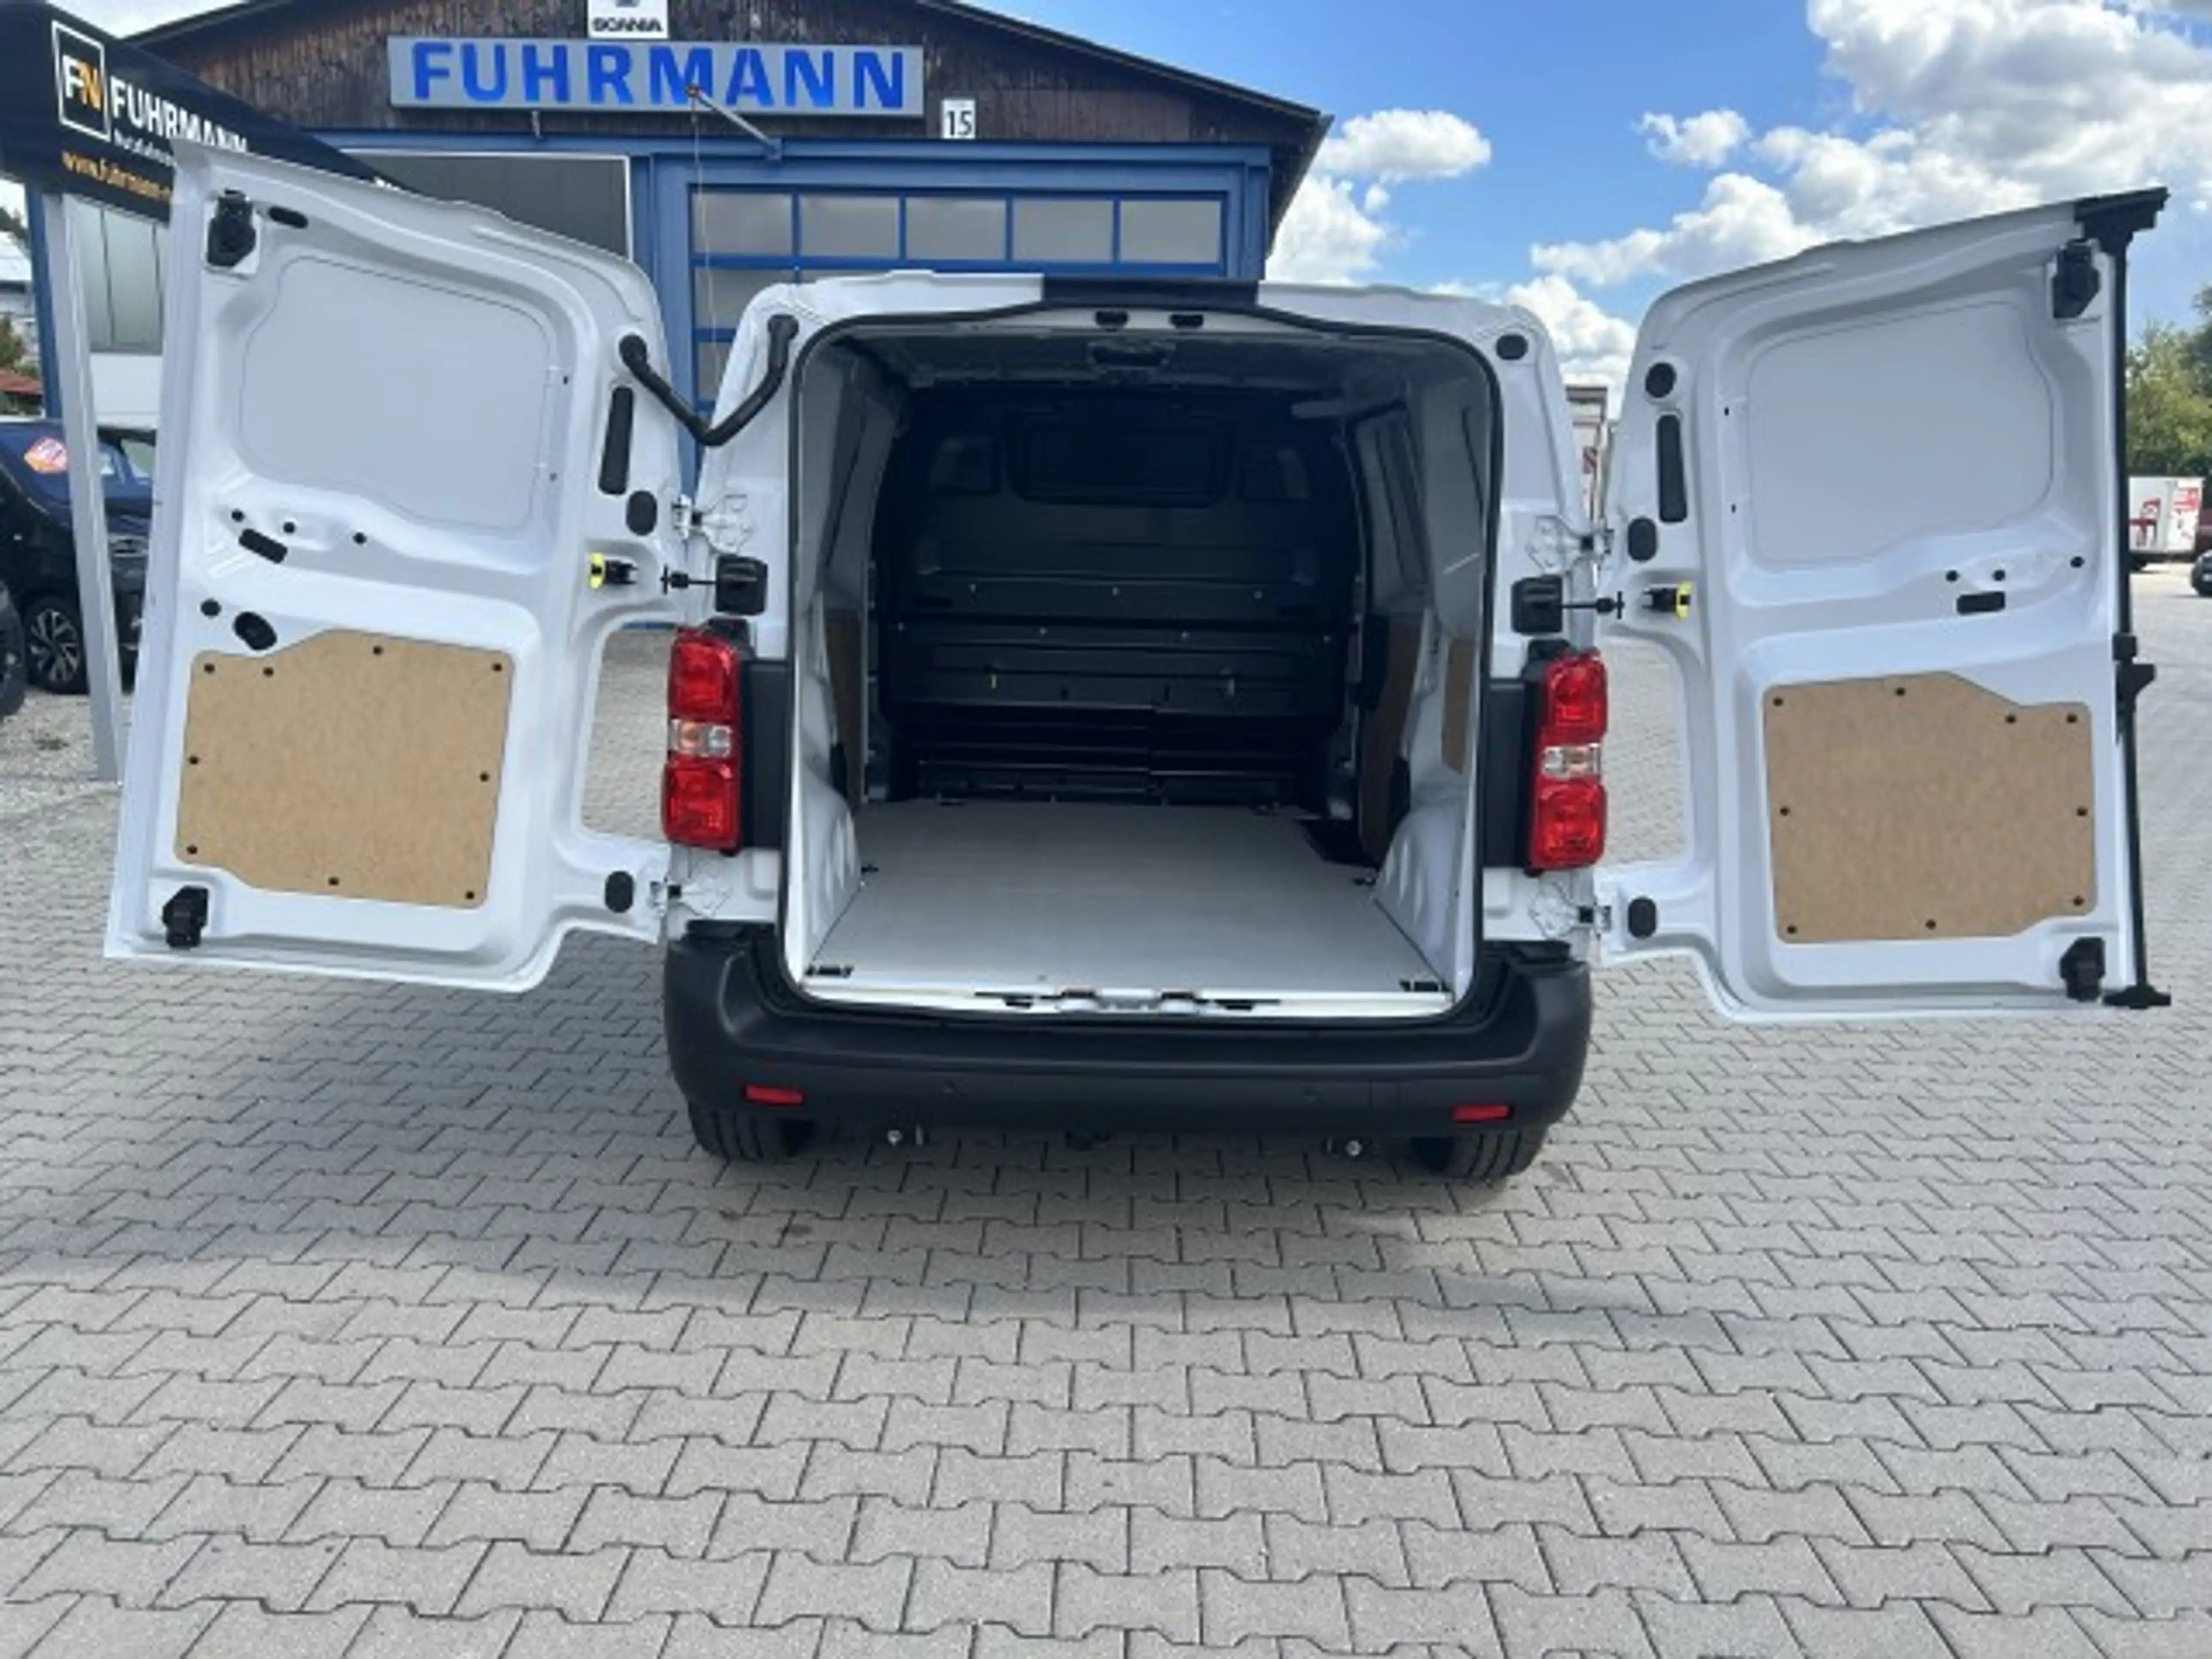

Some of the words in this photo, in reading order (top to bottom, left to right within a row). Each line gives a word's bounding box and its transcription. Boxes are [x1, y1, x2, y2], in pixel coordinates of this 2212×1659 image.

[592, 16, 663, 32] SCANIA
[411, 41, 904, 109] FUHRMANN
[946, 109, 972, 136] 15
